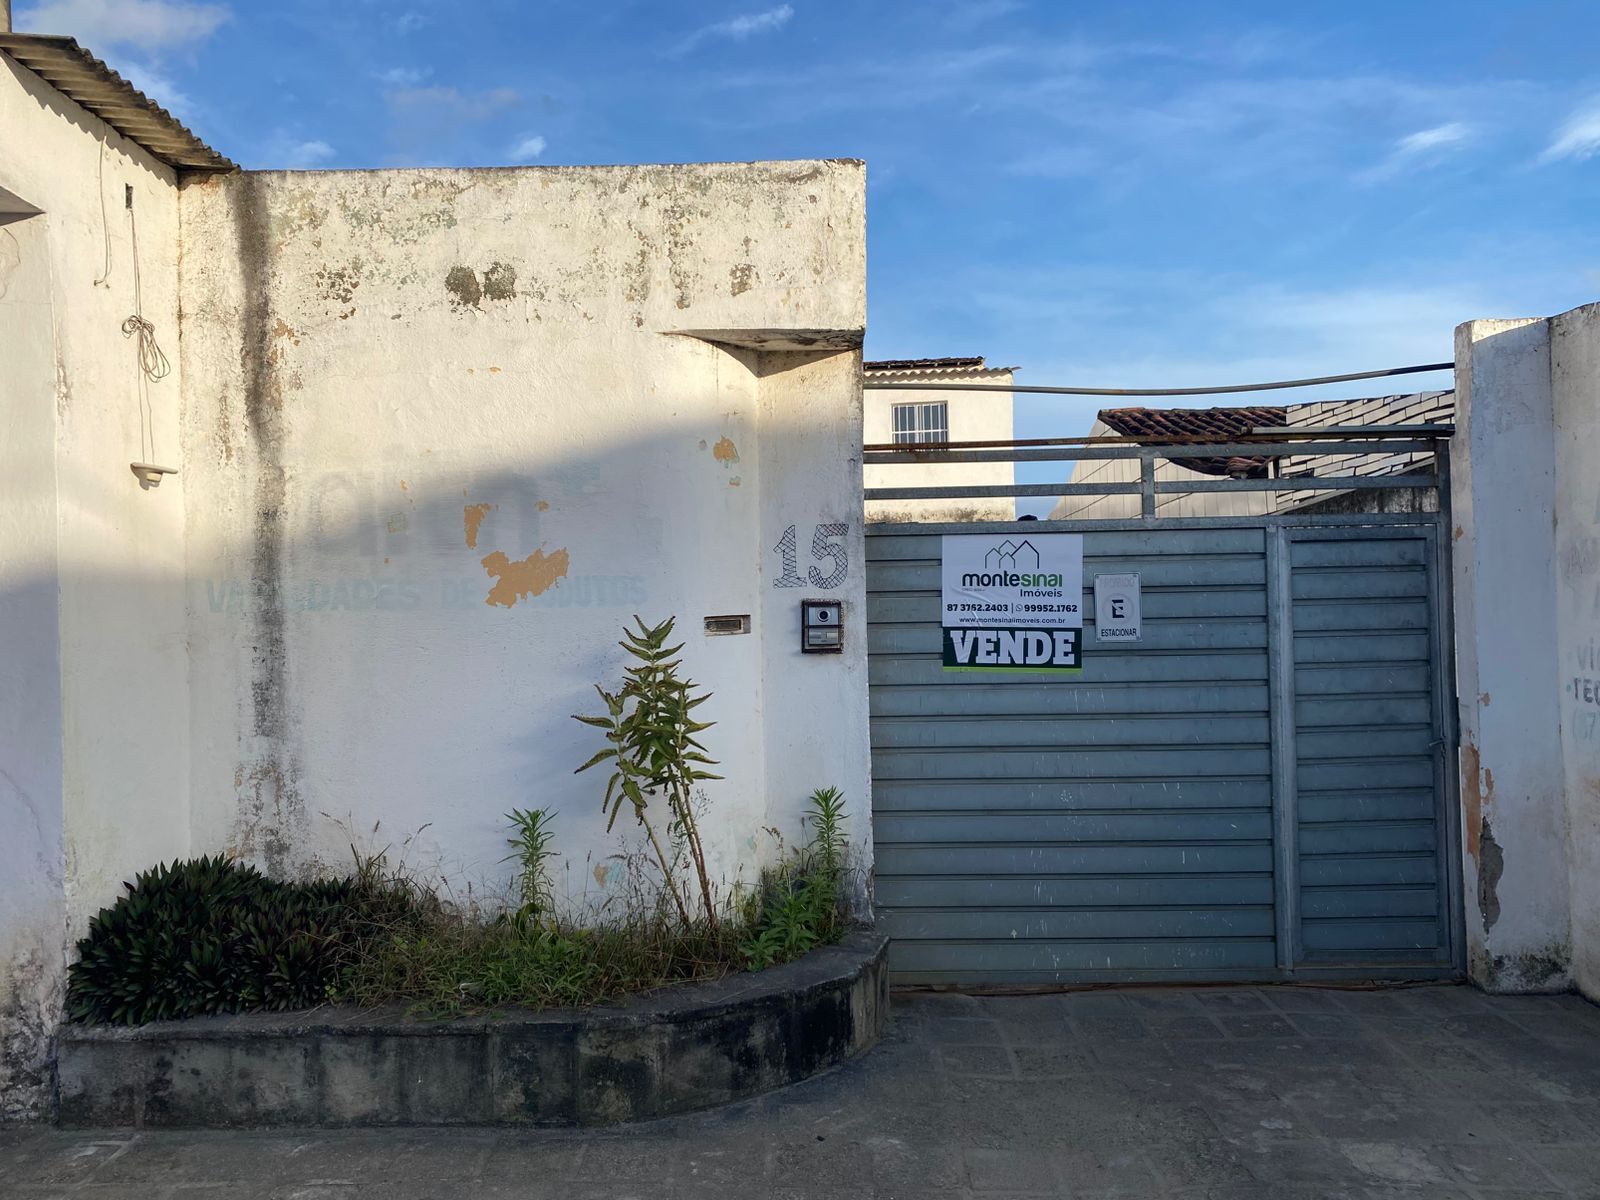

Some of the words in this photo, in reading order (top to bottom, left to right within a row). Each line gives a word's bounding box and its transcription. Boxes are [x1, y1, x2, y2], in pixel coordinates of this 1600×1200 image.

[772, 523, 850, 590] 15
[962, 570, 1063, 587] montesinai
[1020, 588, 1063, 598] Imóveis
[947, 604, 958, 612] 87
[960, 603, 1009, 613] 3762.2403
[1024, 604, 1078, 613] 99952.1762
[1111, 599, 1125, 619] E
[1100, 627, 1137, 638] ESTACIONAR
[950, 630, 1075, 665] VENDE
